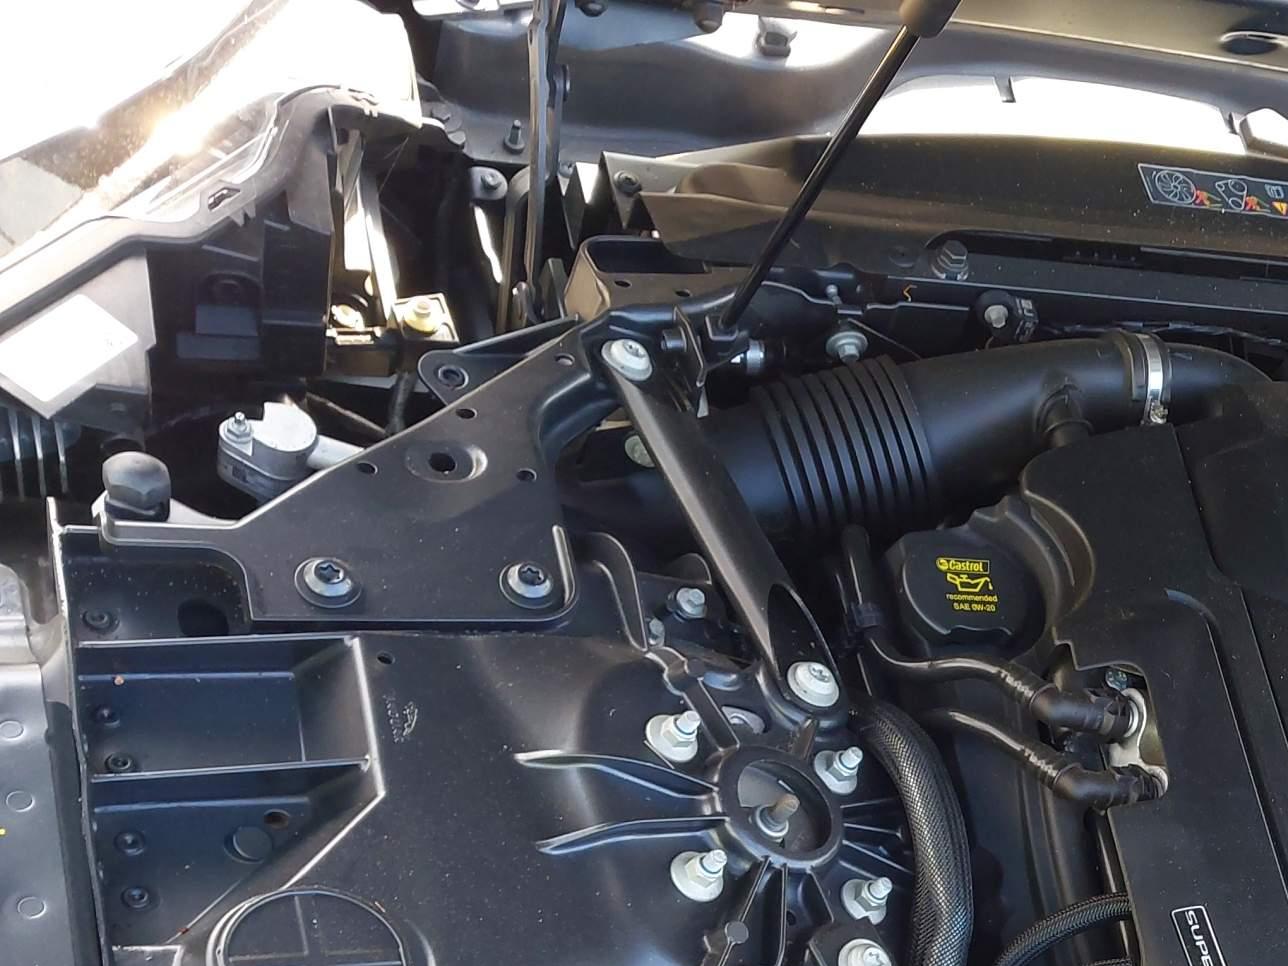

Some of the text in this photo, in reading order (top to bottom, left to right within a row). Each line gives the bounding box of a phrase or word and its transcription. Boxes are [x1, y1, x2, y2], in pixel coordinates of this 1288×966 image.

[949, 560, 983, 572] Castrol
[945, 593, 999, 602] recommended
[953, 602, 971, 611] SAE
